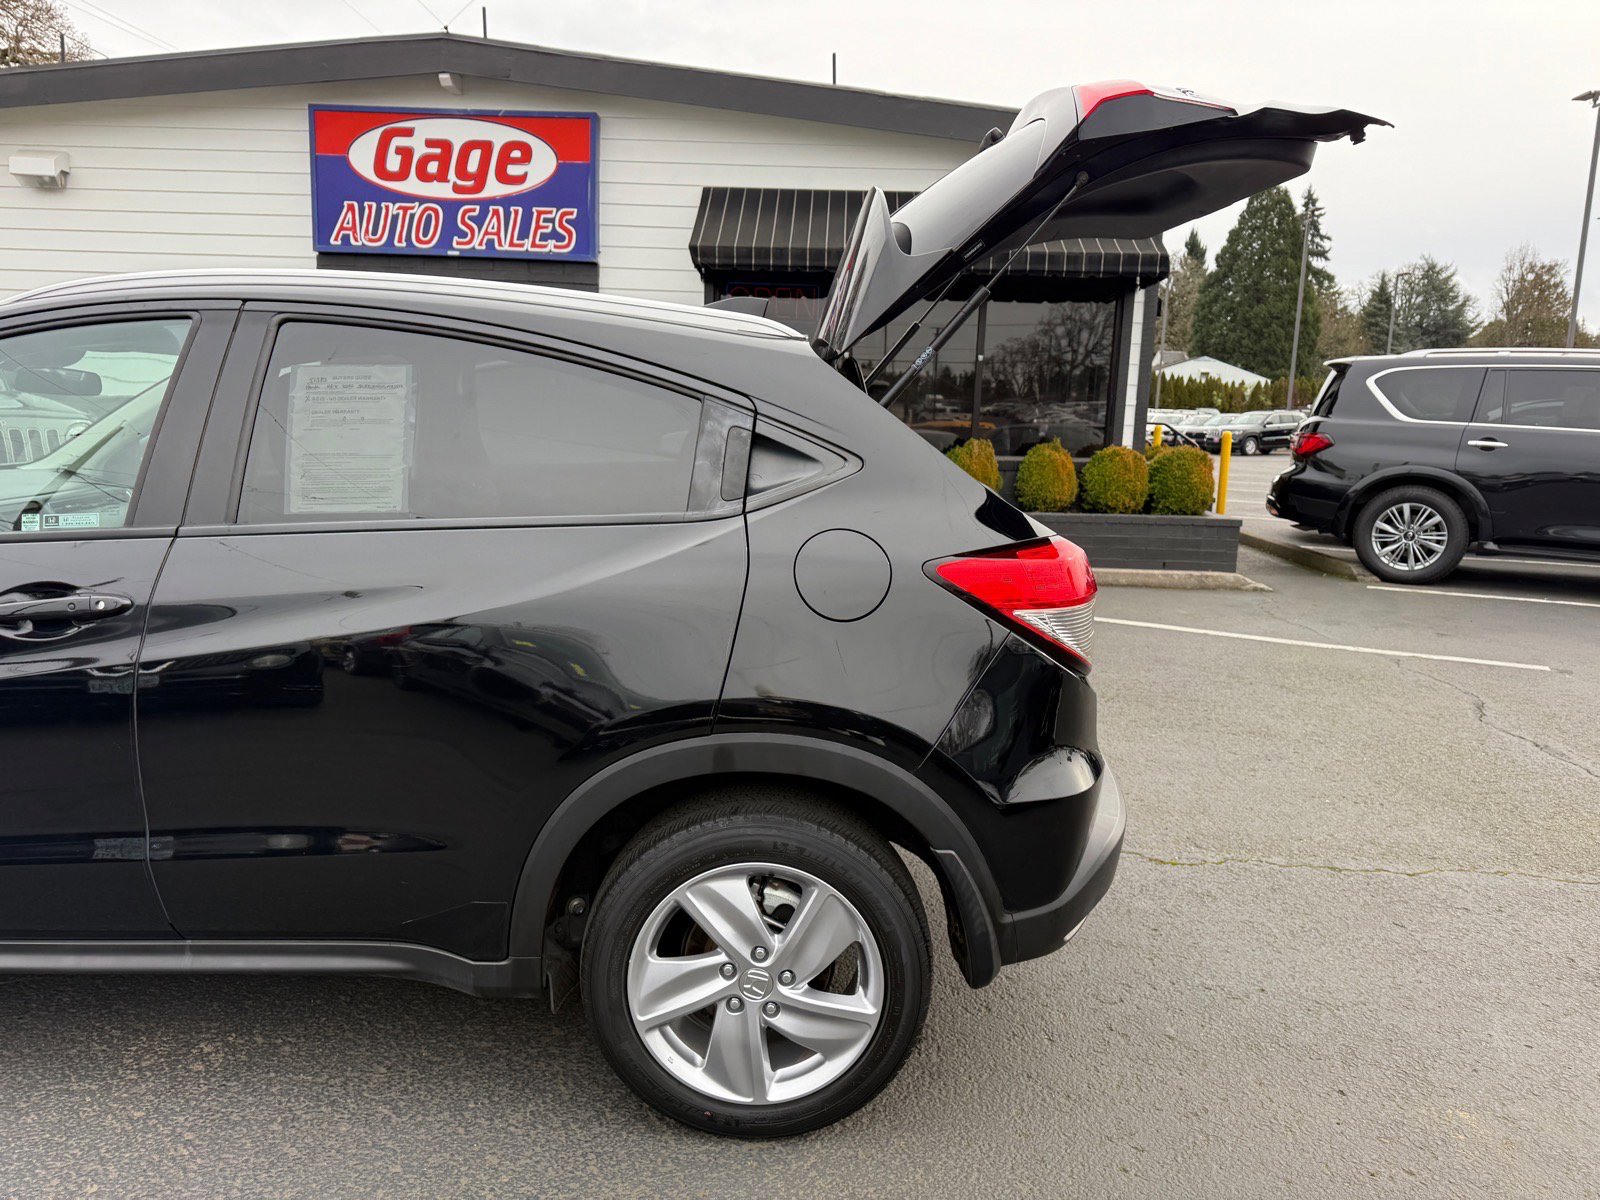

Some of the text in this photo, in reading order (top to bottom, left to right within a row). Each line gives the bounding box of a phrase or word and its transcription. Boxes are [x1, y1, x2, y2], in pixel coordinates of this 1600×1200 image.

[373, 126, 533, 195] Gage
[330, 200, 577, 252] AUTO SALES
